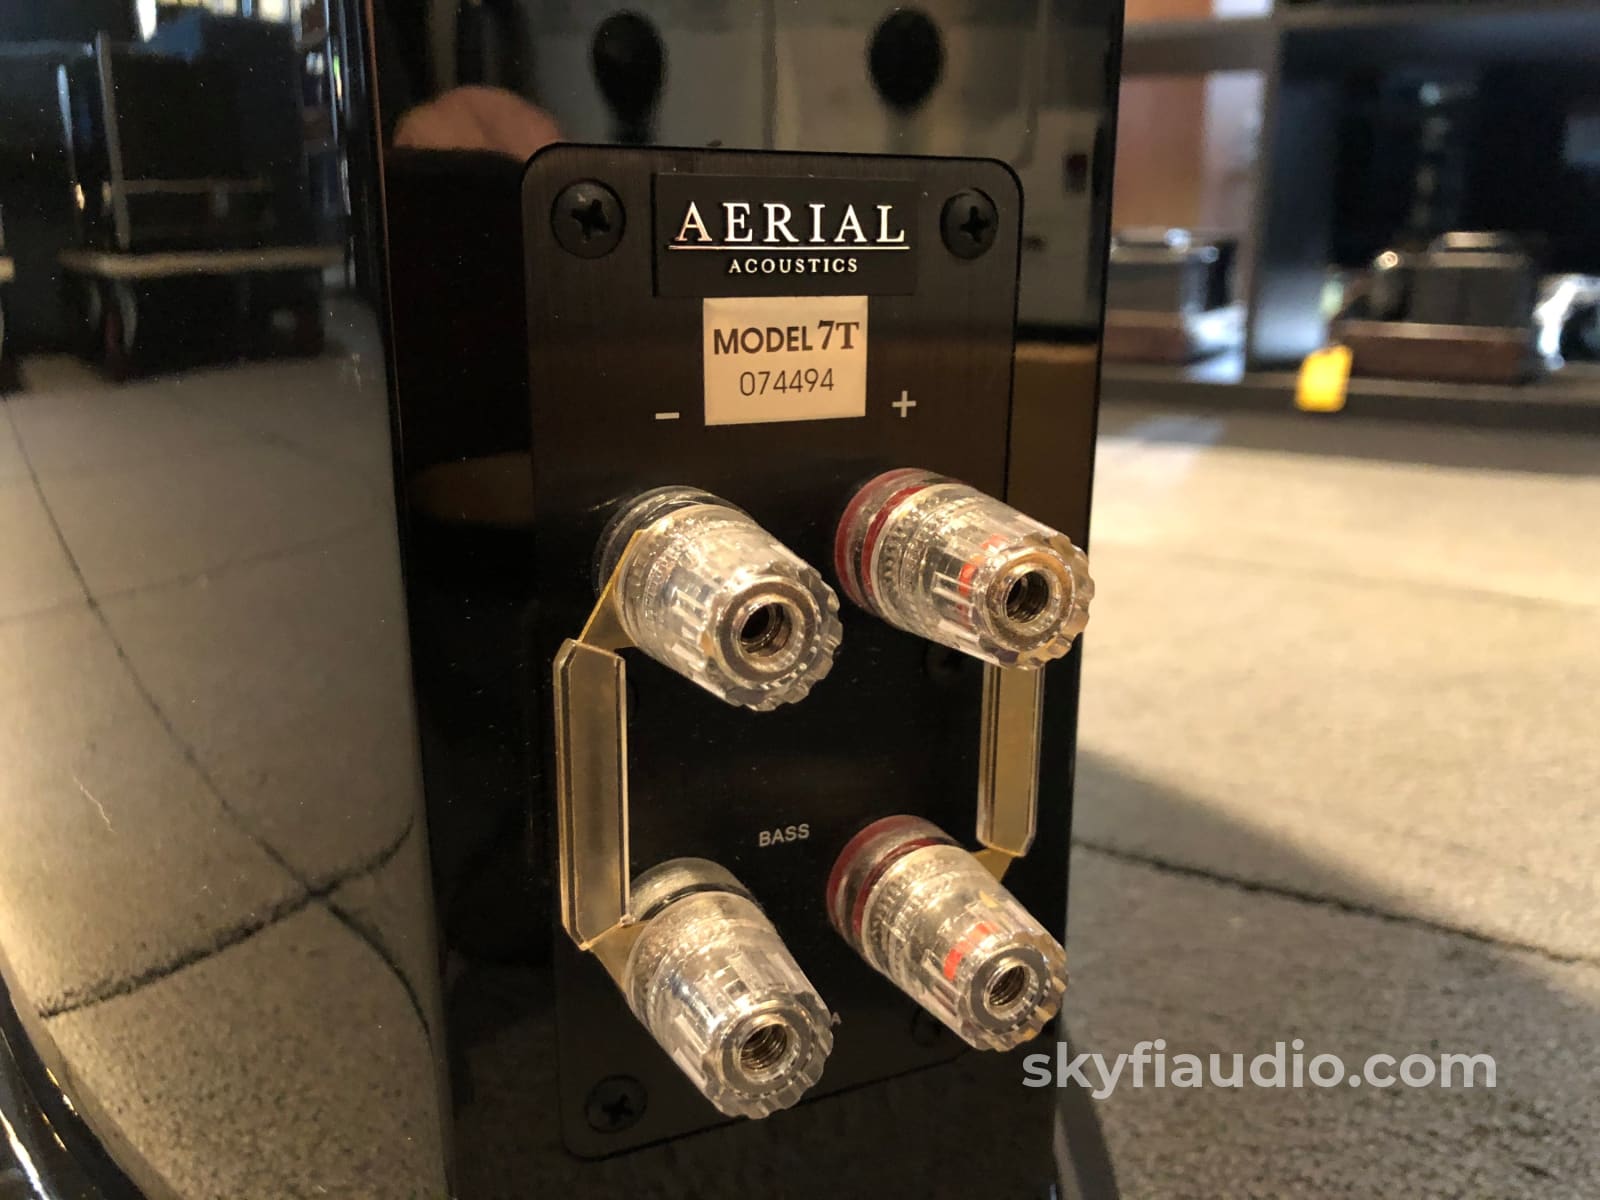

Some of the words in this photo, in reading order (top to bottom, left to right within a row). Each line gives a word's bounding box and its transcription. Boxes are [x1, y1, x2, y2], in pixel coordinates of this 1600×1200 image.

[674, 201, 905, 243] AERIAL
[728, 258, 858, 274] ACOUSTICS
[713, 326, 813, 355] MODEL
[817, 320, 860, 350] 7T
[739, 368, 835, 396] 074494
[759, 823, 810, 847] BASS
